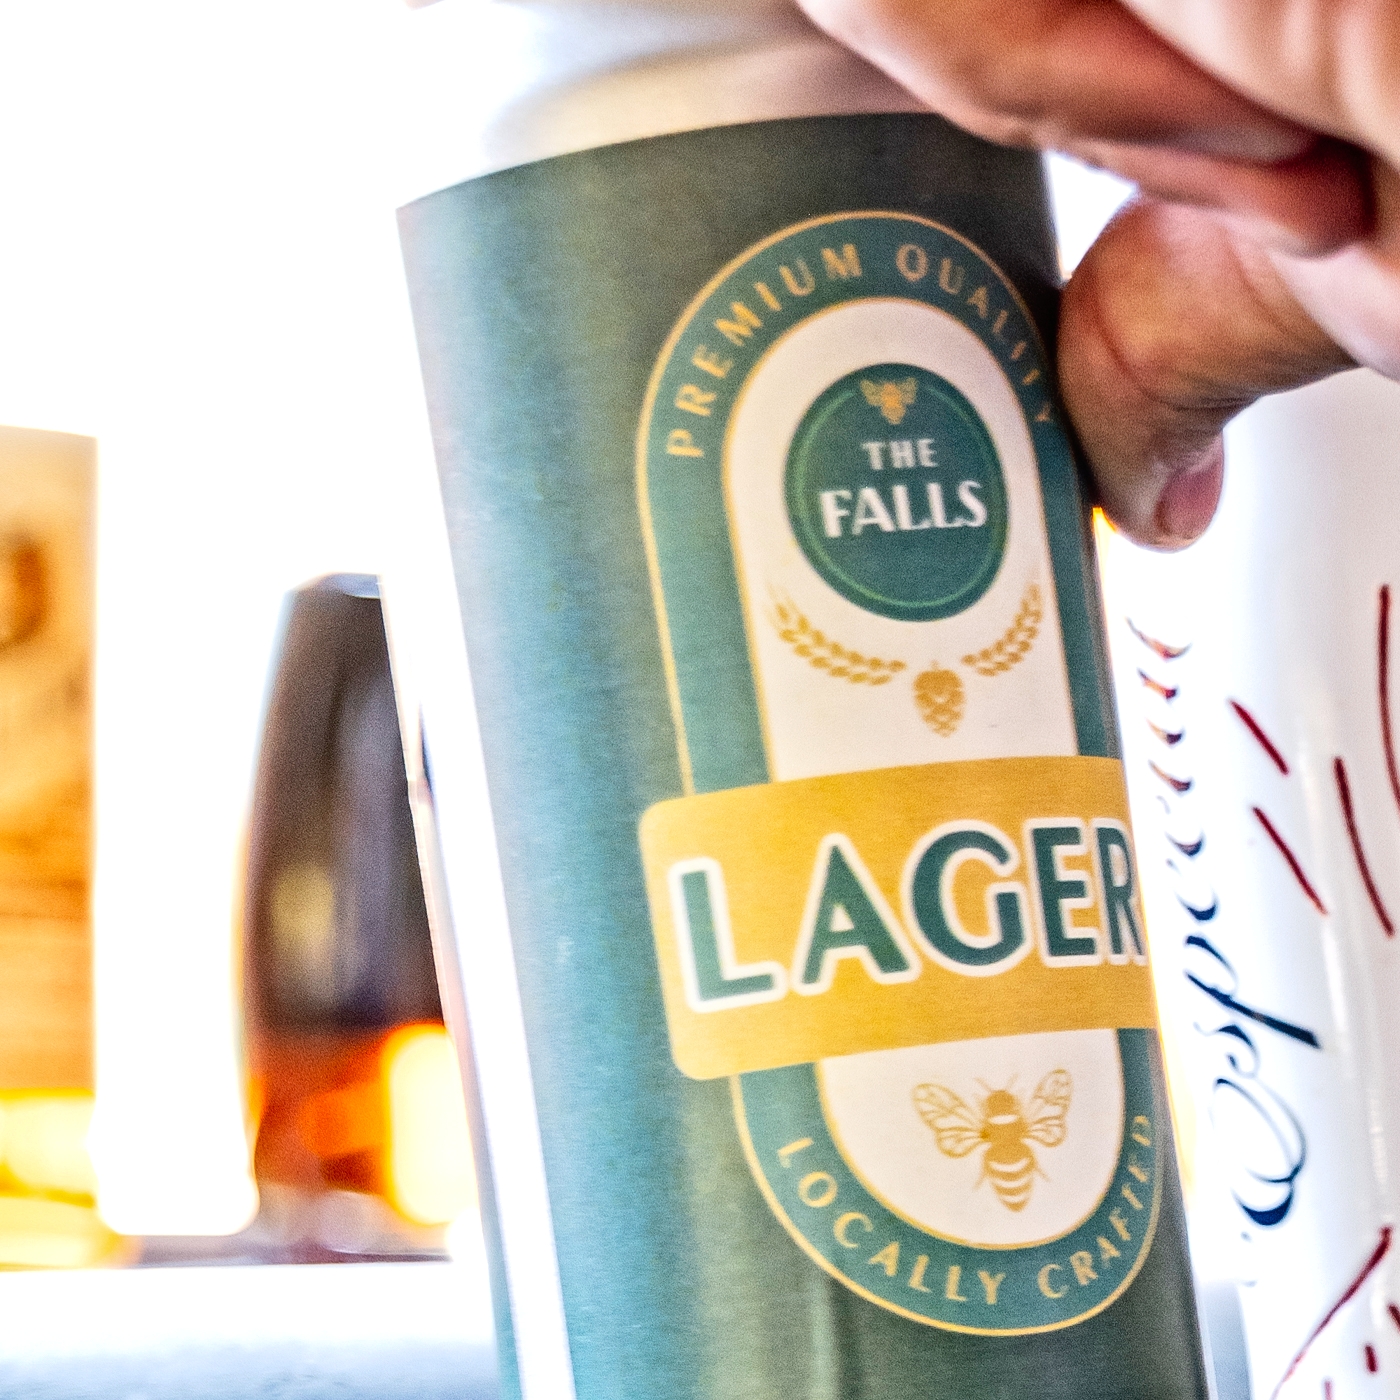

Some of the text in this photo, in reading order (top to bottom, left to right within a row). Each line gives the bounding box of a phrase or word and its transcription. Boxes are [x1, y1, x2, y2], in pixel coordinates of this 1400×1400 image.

[666, 242, 1052, 459] PREMIUM QUALITY
[818, 479, 988, 539] FALLS
[860, 437, 939, 471] THE
[670, 817, 1147, 1011] LAGER
[776, 1114, 1152, 1305] LOCALLY CRAFTED
